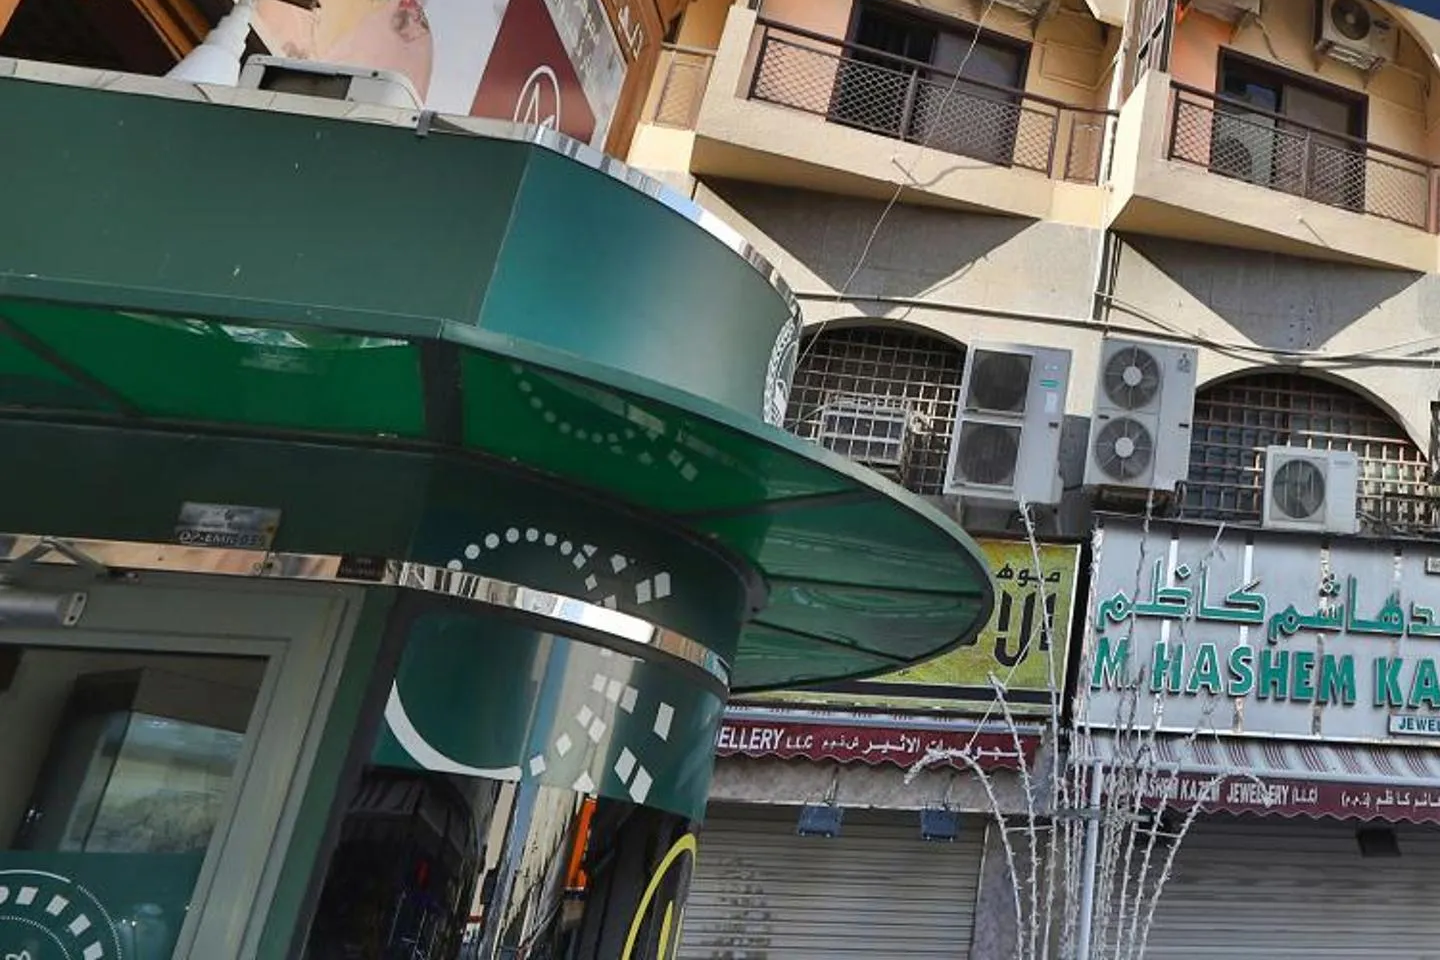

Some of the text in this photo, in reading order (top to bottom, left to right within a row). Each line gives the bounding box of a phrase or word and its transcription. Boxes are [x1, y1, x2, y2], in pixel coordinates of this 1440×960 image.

[1097, 557, 1267, 632] كاظم
[1268, 574, 1404, 644] هاشم
[1150, 641, 1356, 707] HASHEM
